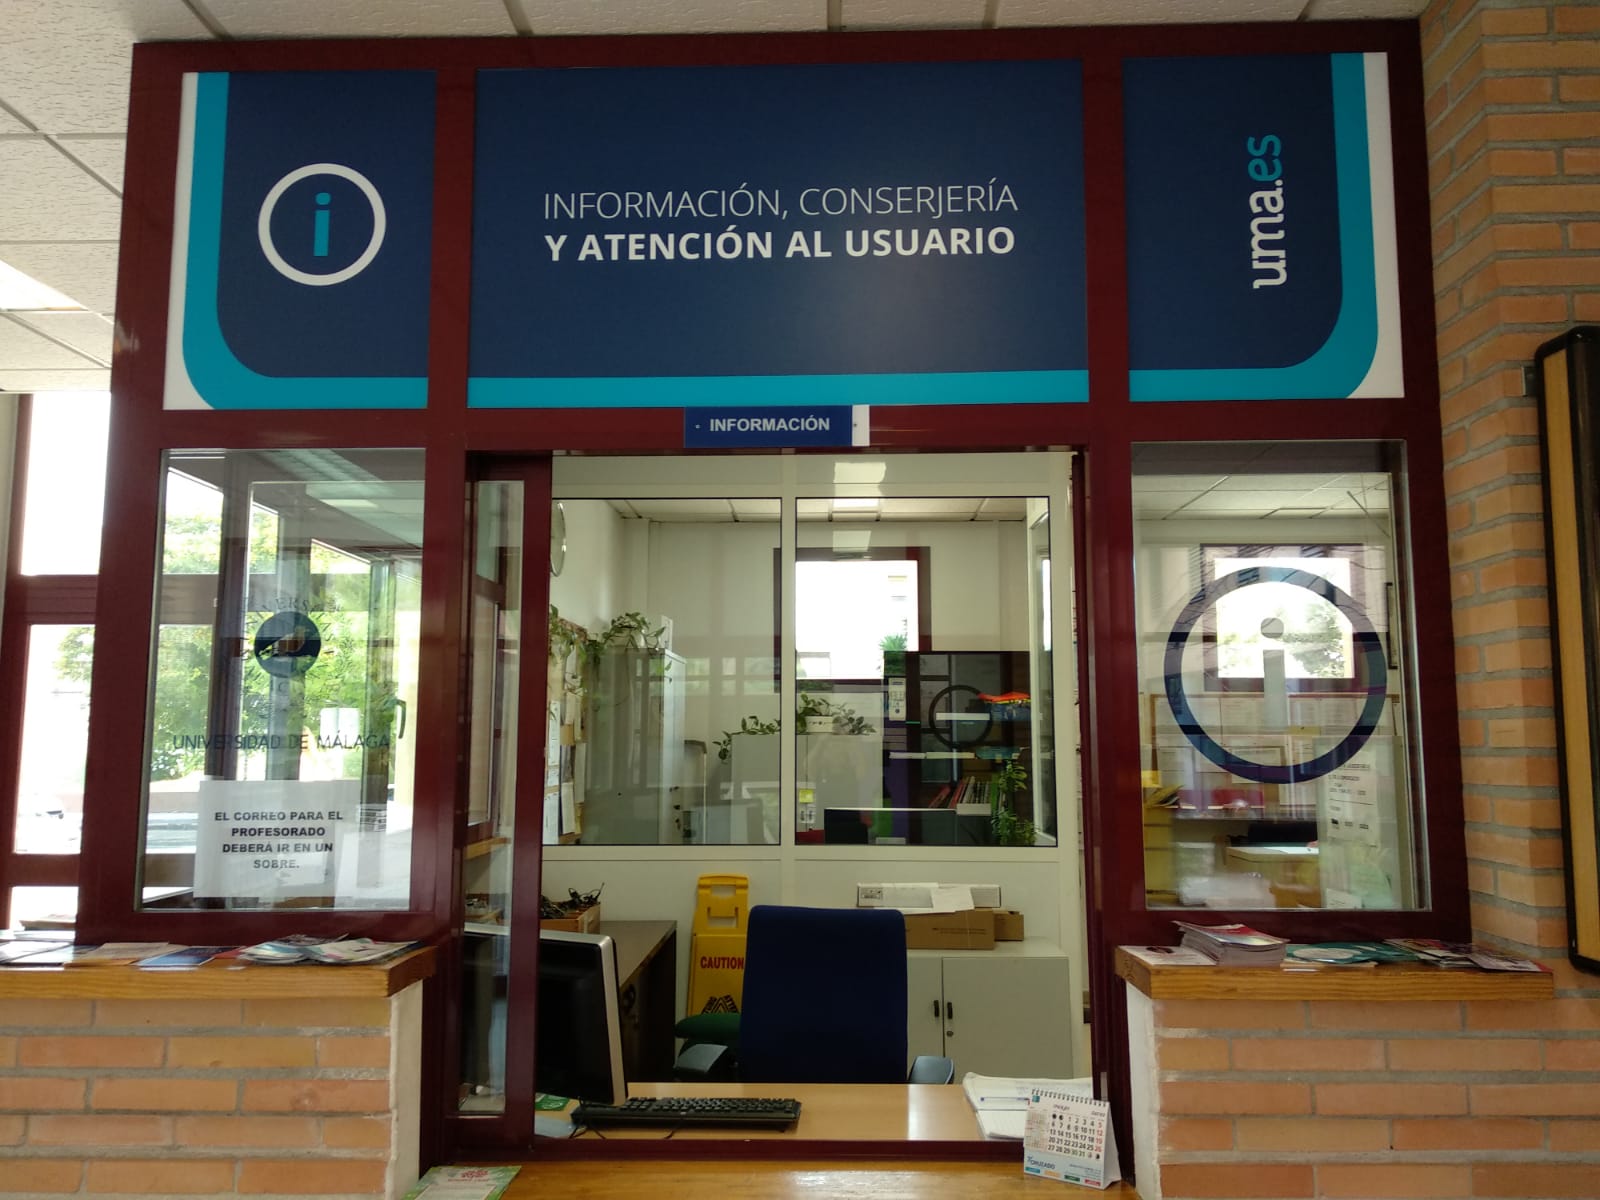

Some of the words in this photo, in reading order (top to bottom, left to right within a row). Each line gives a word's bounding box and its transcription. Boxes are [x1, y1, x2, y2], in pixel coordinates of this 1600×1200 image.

[544, 182, 788, 220] INFORMACIÓN,
[799, 177, 1019, 219] CONSERJERÍA
[1247, 134, 1287, 289] uma.es
[544, 234, 568, 261] Y
[577, 224, 772, 261] ATENCIÓN
[785, 230, 832, 258] AL
[845, 226, 1015, 257] USUARIO
[709, 415, 831, 432] INFORMACIÓN
[173, 734, 281, 750] UNIVERSIDAD
[288, 734, 309, 750] DE
[316, 730, 390, 750] MÁLAGA
[214, 811, 230, 821] EL
[233, 811, 286, 821] CORREO
[290, 811, 325, 821] PARA
[327, 811, 344, 821] EL
[231, 826, 326, 837] PROFESORADO
[222, 840, 273, 853] DEBERÁ
[276, 843, 290, 853] IR
[294, 843, 311, 853] EN
[315, 842, 334, 853] UN
[253, 859, 300, 869] SOBRE.
[700, 956, 744, 969] CAUTION
